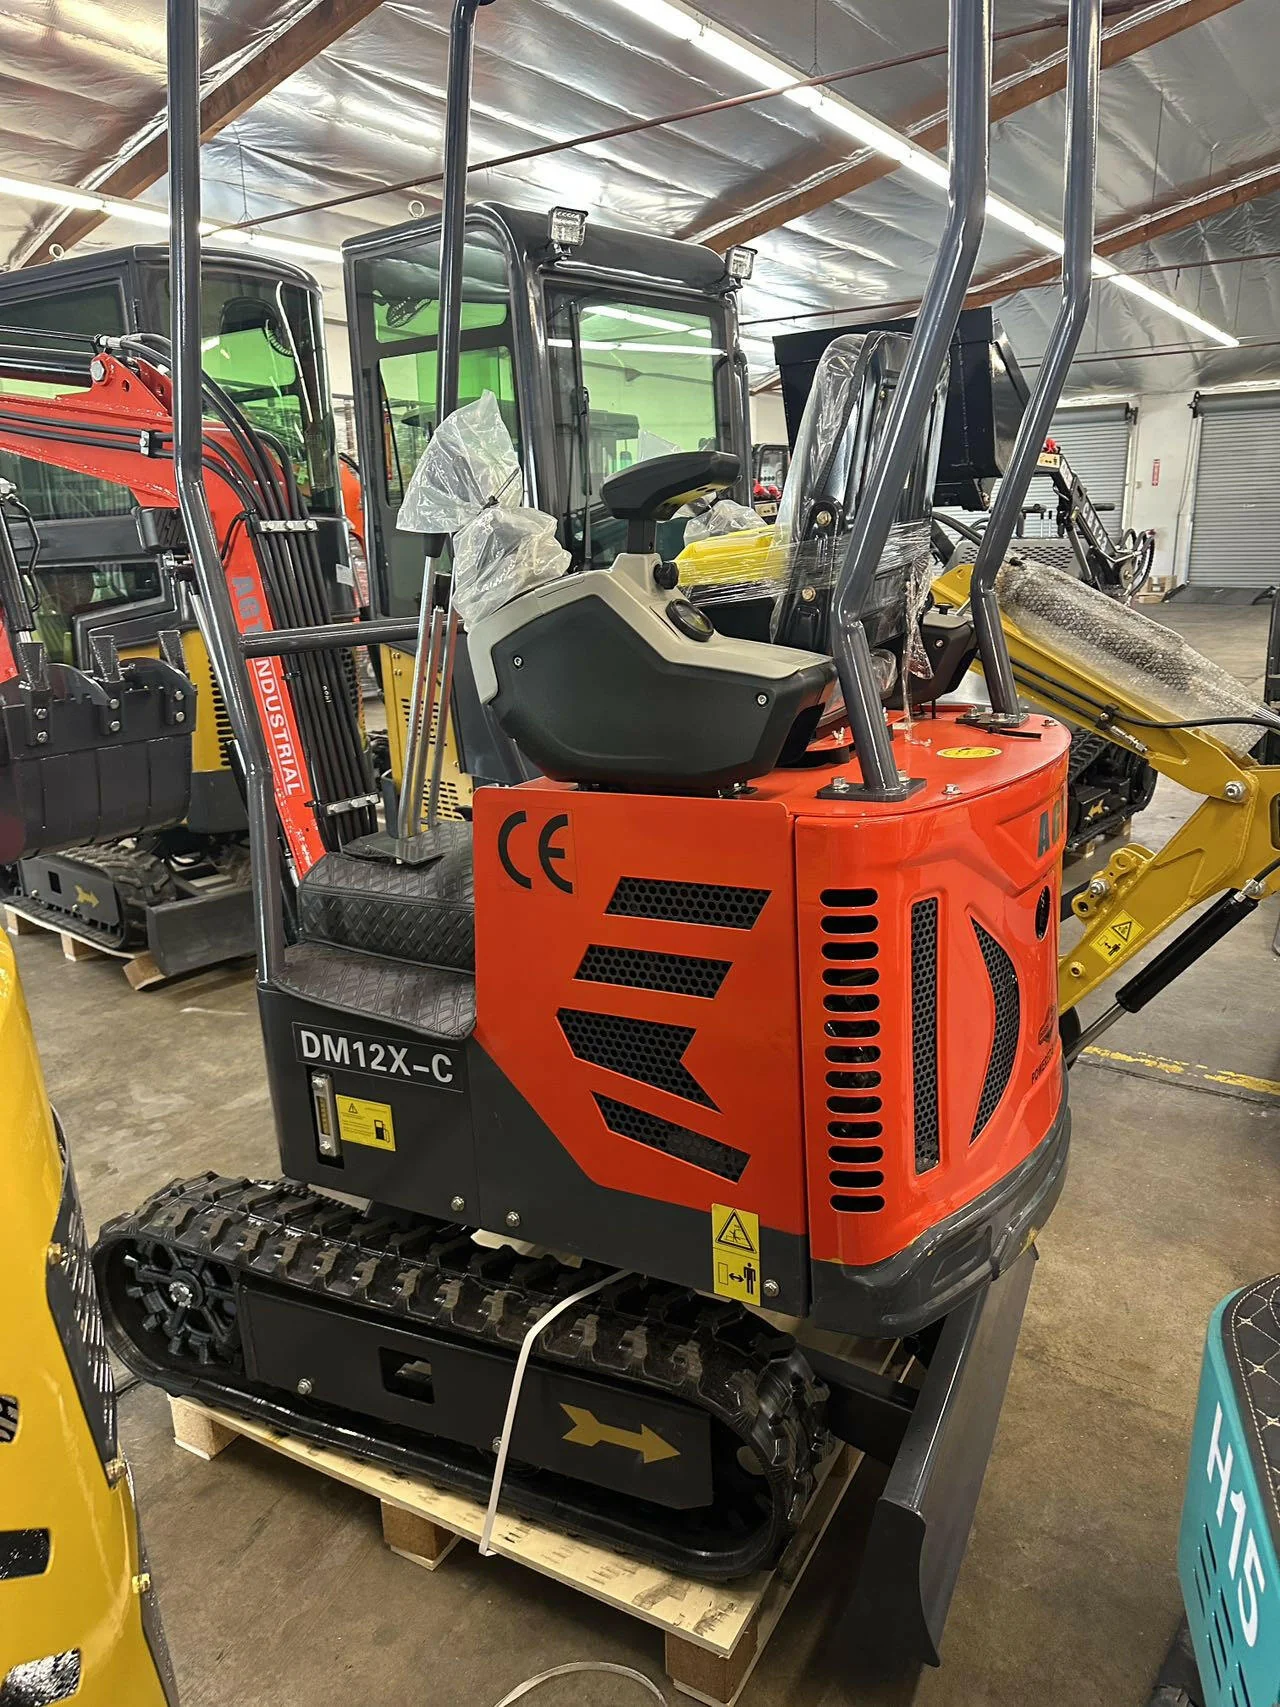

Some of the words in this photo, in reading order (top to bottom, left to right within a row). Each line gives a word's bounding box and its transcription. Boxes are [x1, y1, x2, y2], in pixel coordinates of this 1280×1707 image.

[255, 659, 299, 796] NDUSTRIAL
[497, 810, 574, 895] CE
[300, 1030, 454, 1084] DM12X-C
[1206, 1400, 1266, 1648] H15
